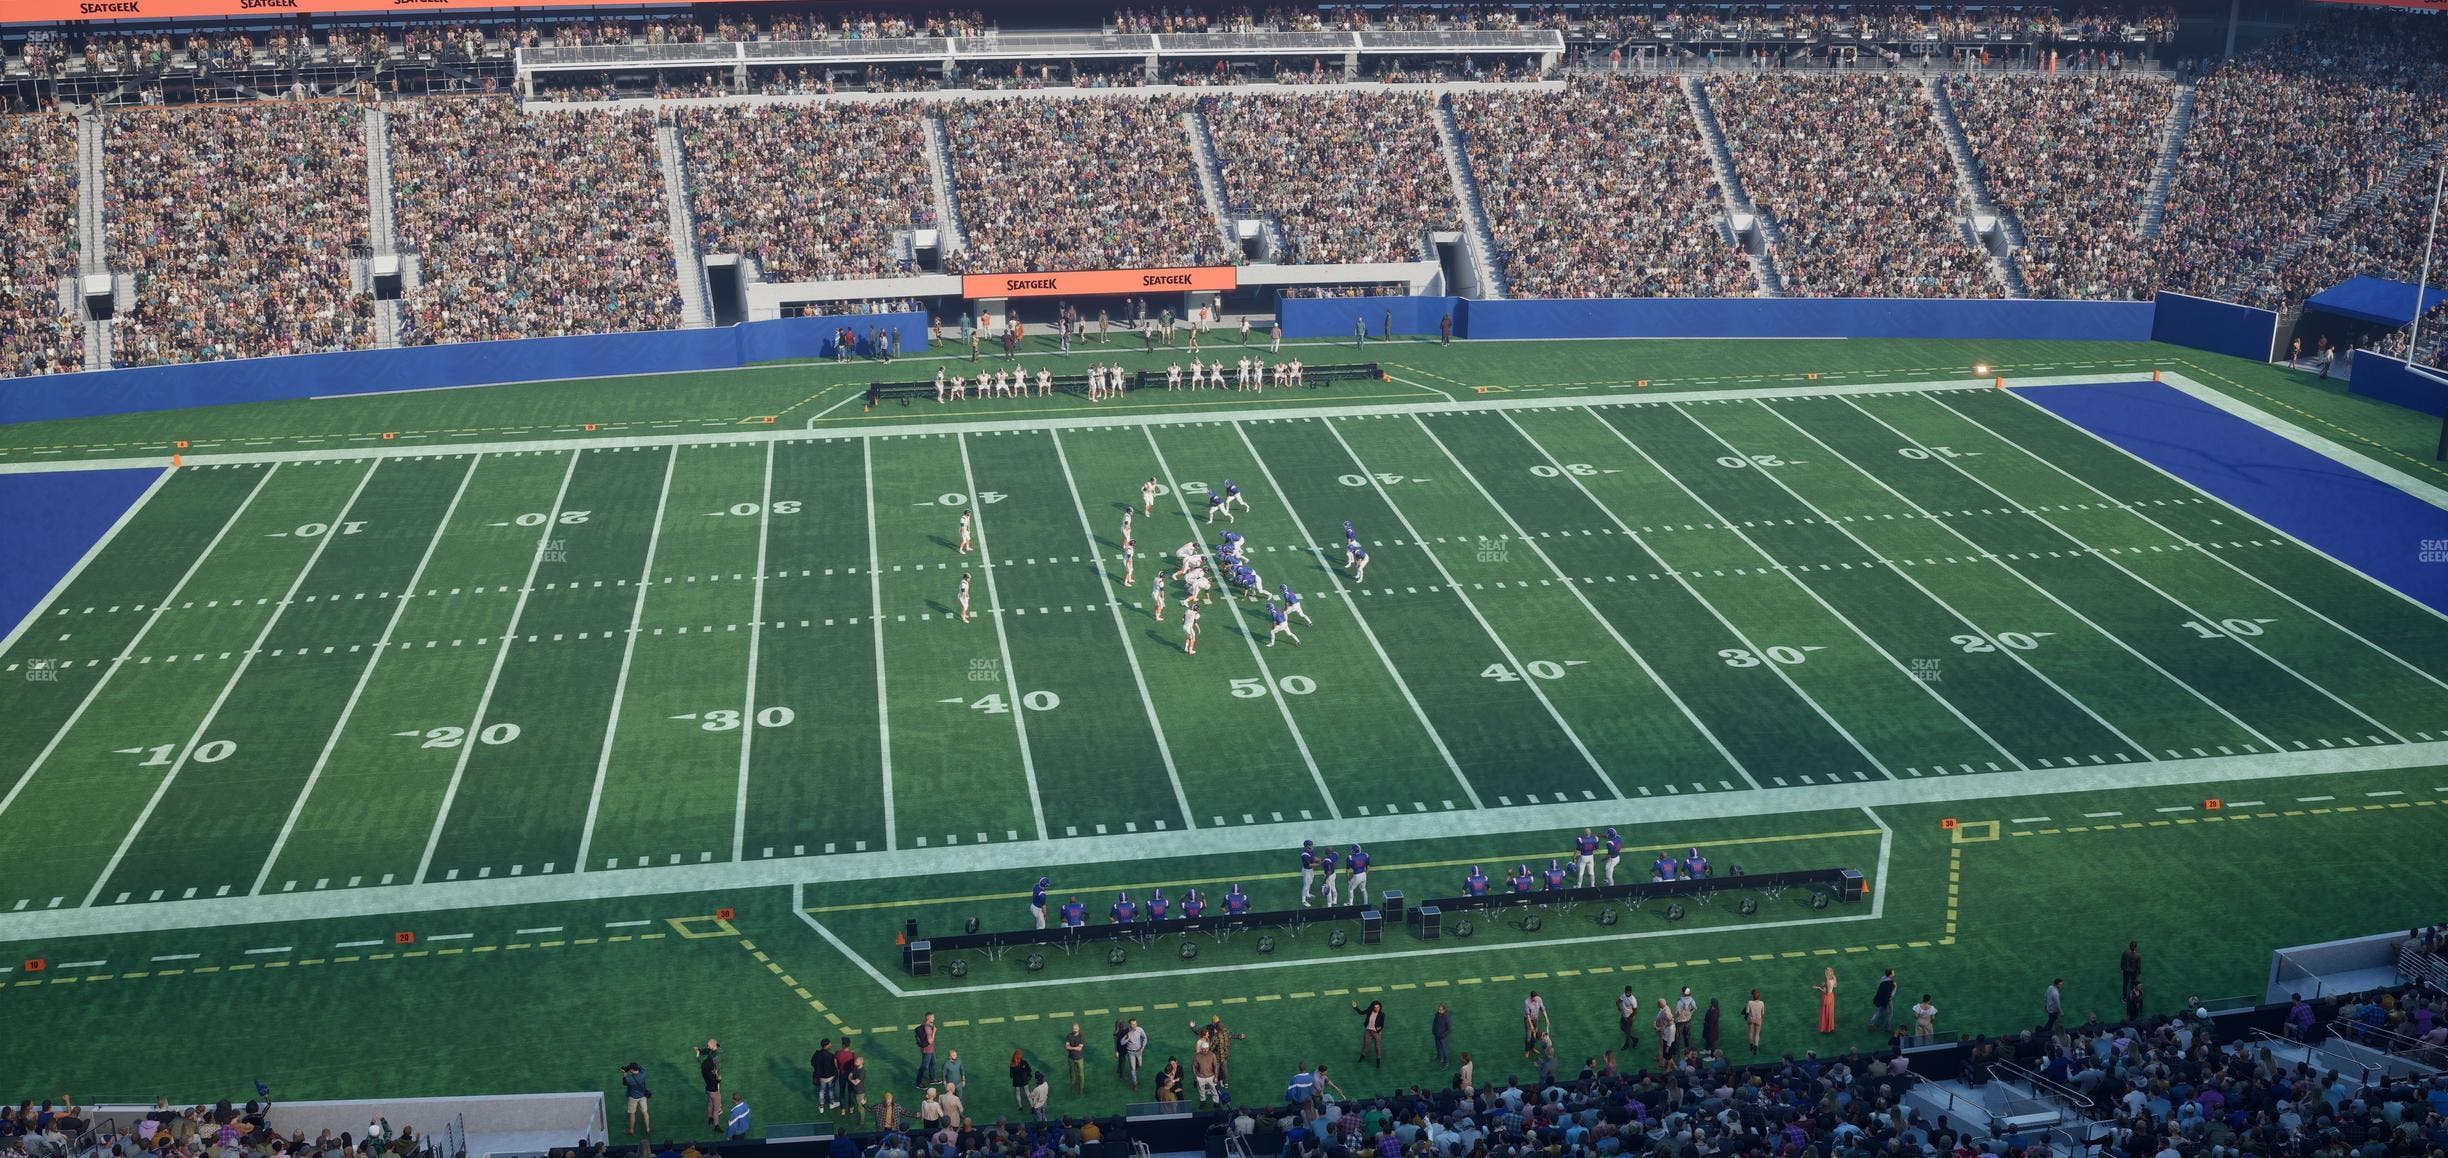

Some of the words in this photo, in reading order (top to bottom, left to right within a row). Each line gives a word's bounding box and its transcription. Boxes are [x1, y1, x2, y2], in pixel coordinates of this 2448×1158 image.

[80, 1, 140, 14] SEATGEEK
[1007, 279, 1057, 291] SEATGEEK
[1143, 274, 1192, 286] SEATGEEK
[1898, 446, 1961, 459] 10
[1716, 454, 1785, 468] 20
[1529, 463, 1598, 477] 30
[1338, 473, 1404, 487] 40
[938, 491, 1009, 506] 40
[730, 500, 802, 516] 30
[515, 510, 591, 527] 20
[294, 521, 368, 537] 10
[2181, 618, 2264, 638] 10
[1950, 632, 2039, 653] 20
[1718, 646, 1806, 668] 30
[1480, 660, 1566, 682] 40
[1229, 675, 1317, 698] 50
[970, 690, 1061, 714] 40
[701, 706, 795, 731] 30
[421, 723, 521, 749] 20
[138, 740, 237, 766] 10
[720, 910, 730, 918] 30
[400, 934, 409, 942] 20
[31, 960, 39, 969] 10
